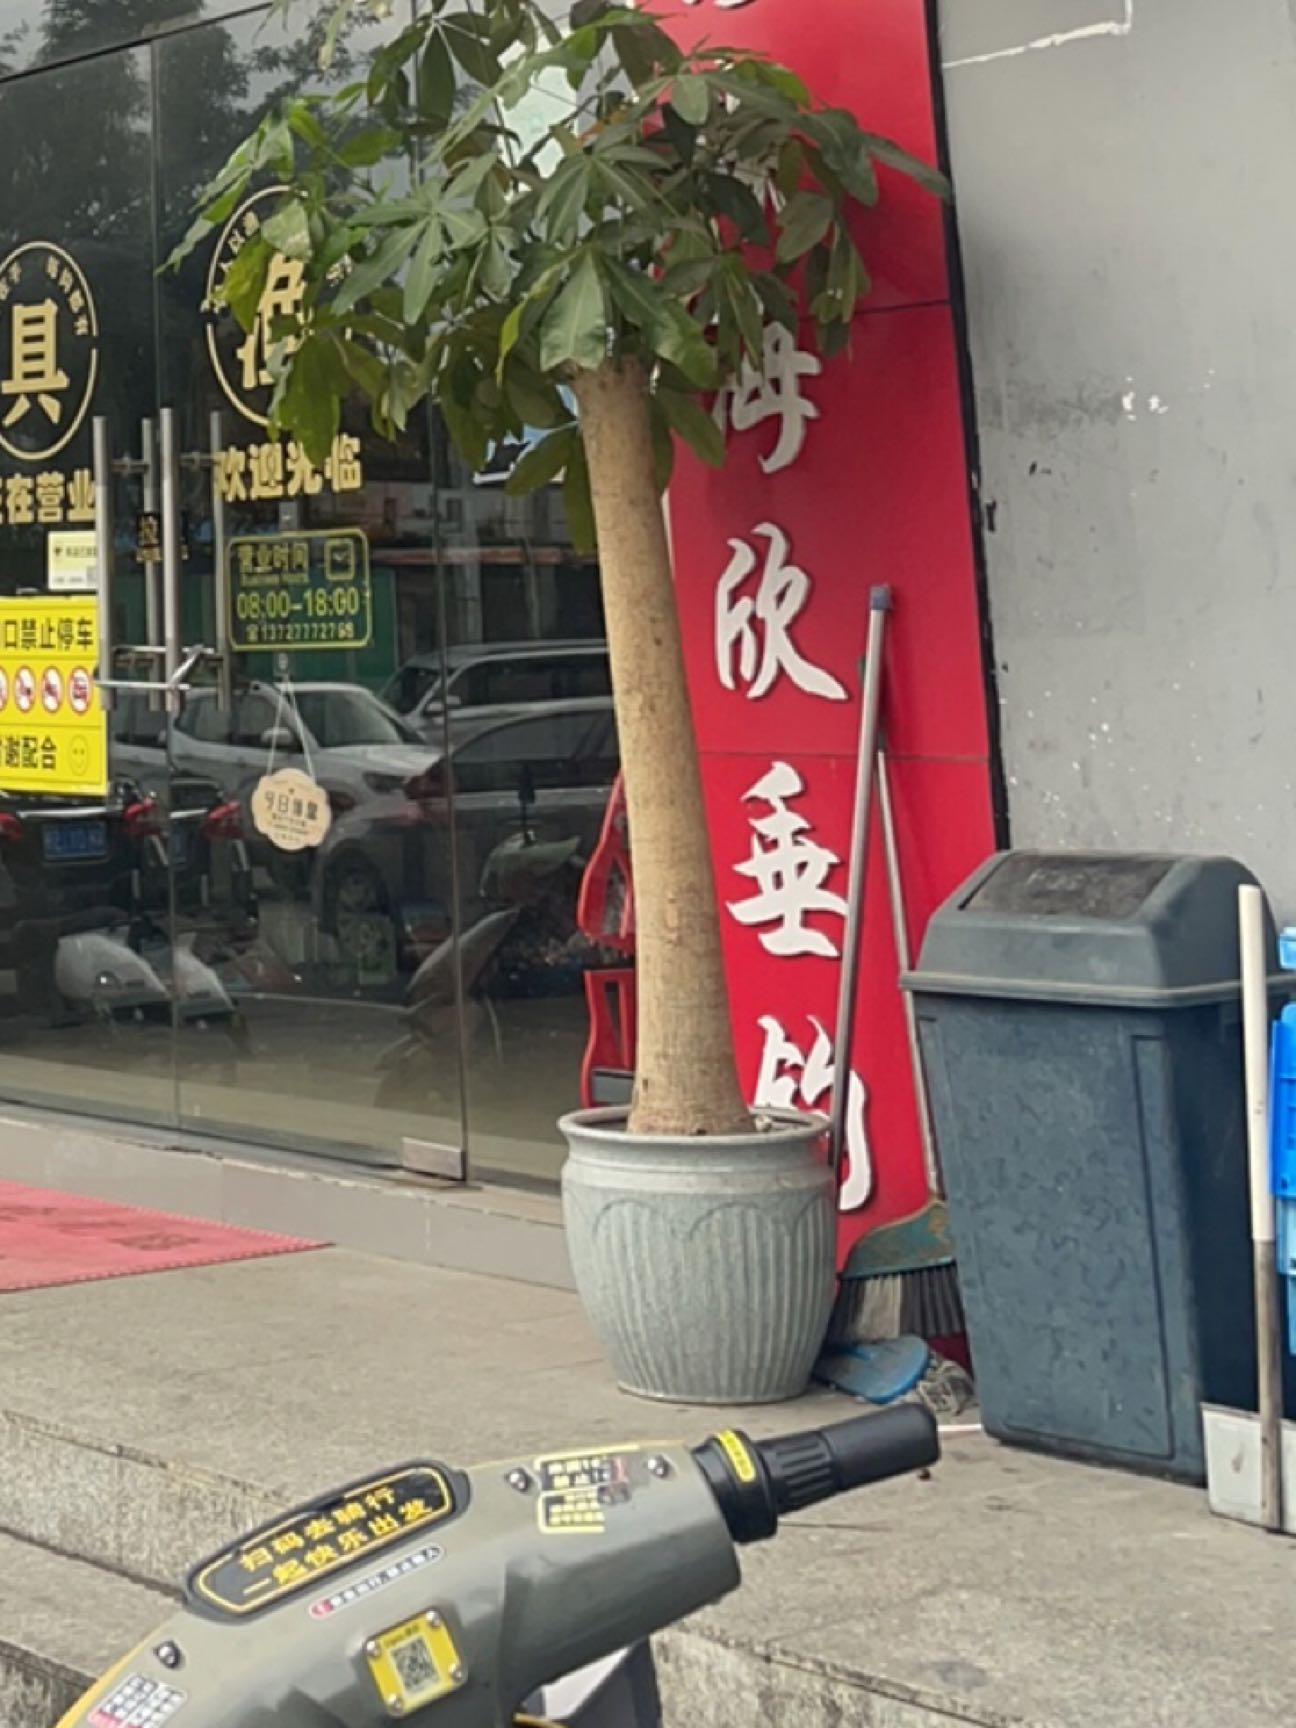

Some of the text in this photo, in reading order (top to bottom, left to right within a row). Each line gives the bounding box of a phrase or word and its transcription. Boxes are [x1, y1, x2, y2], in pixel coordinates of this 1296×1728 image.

[0, 297, 70, 428] 具
[215, 435, 362, 502] 欢迎光临
